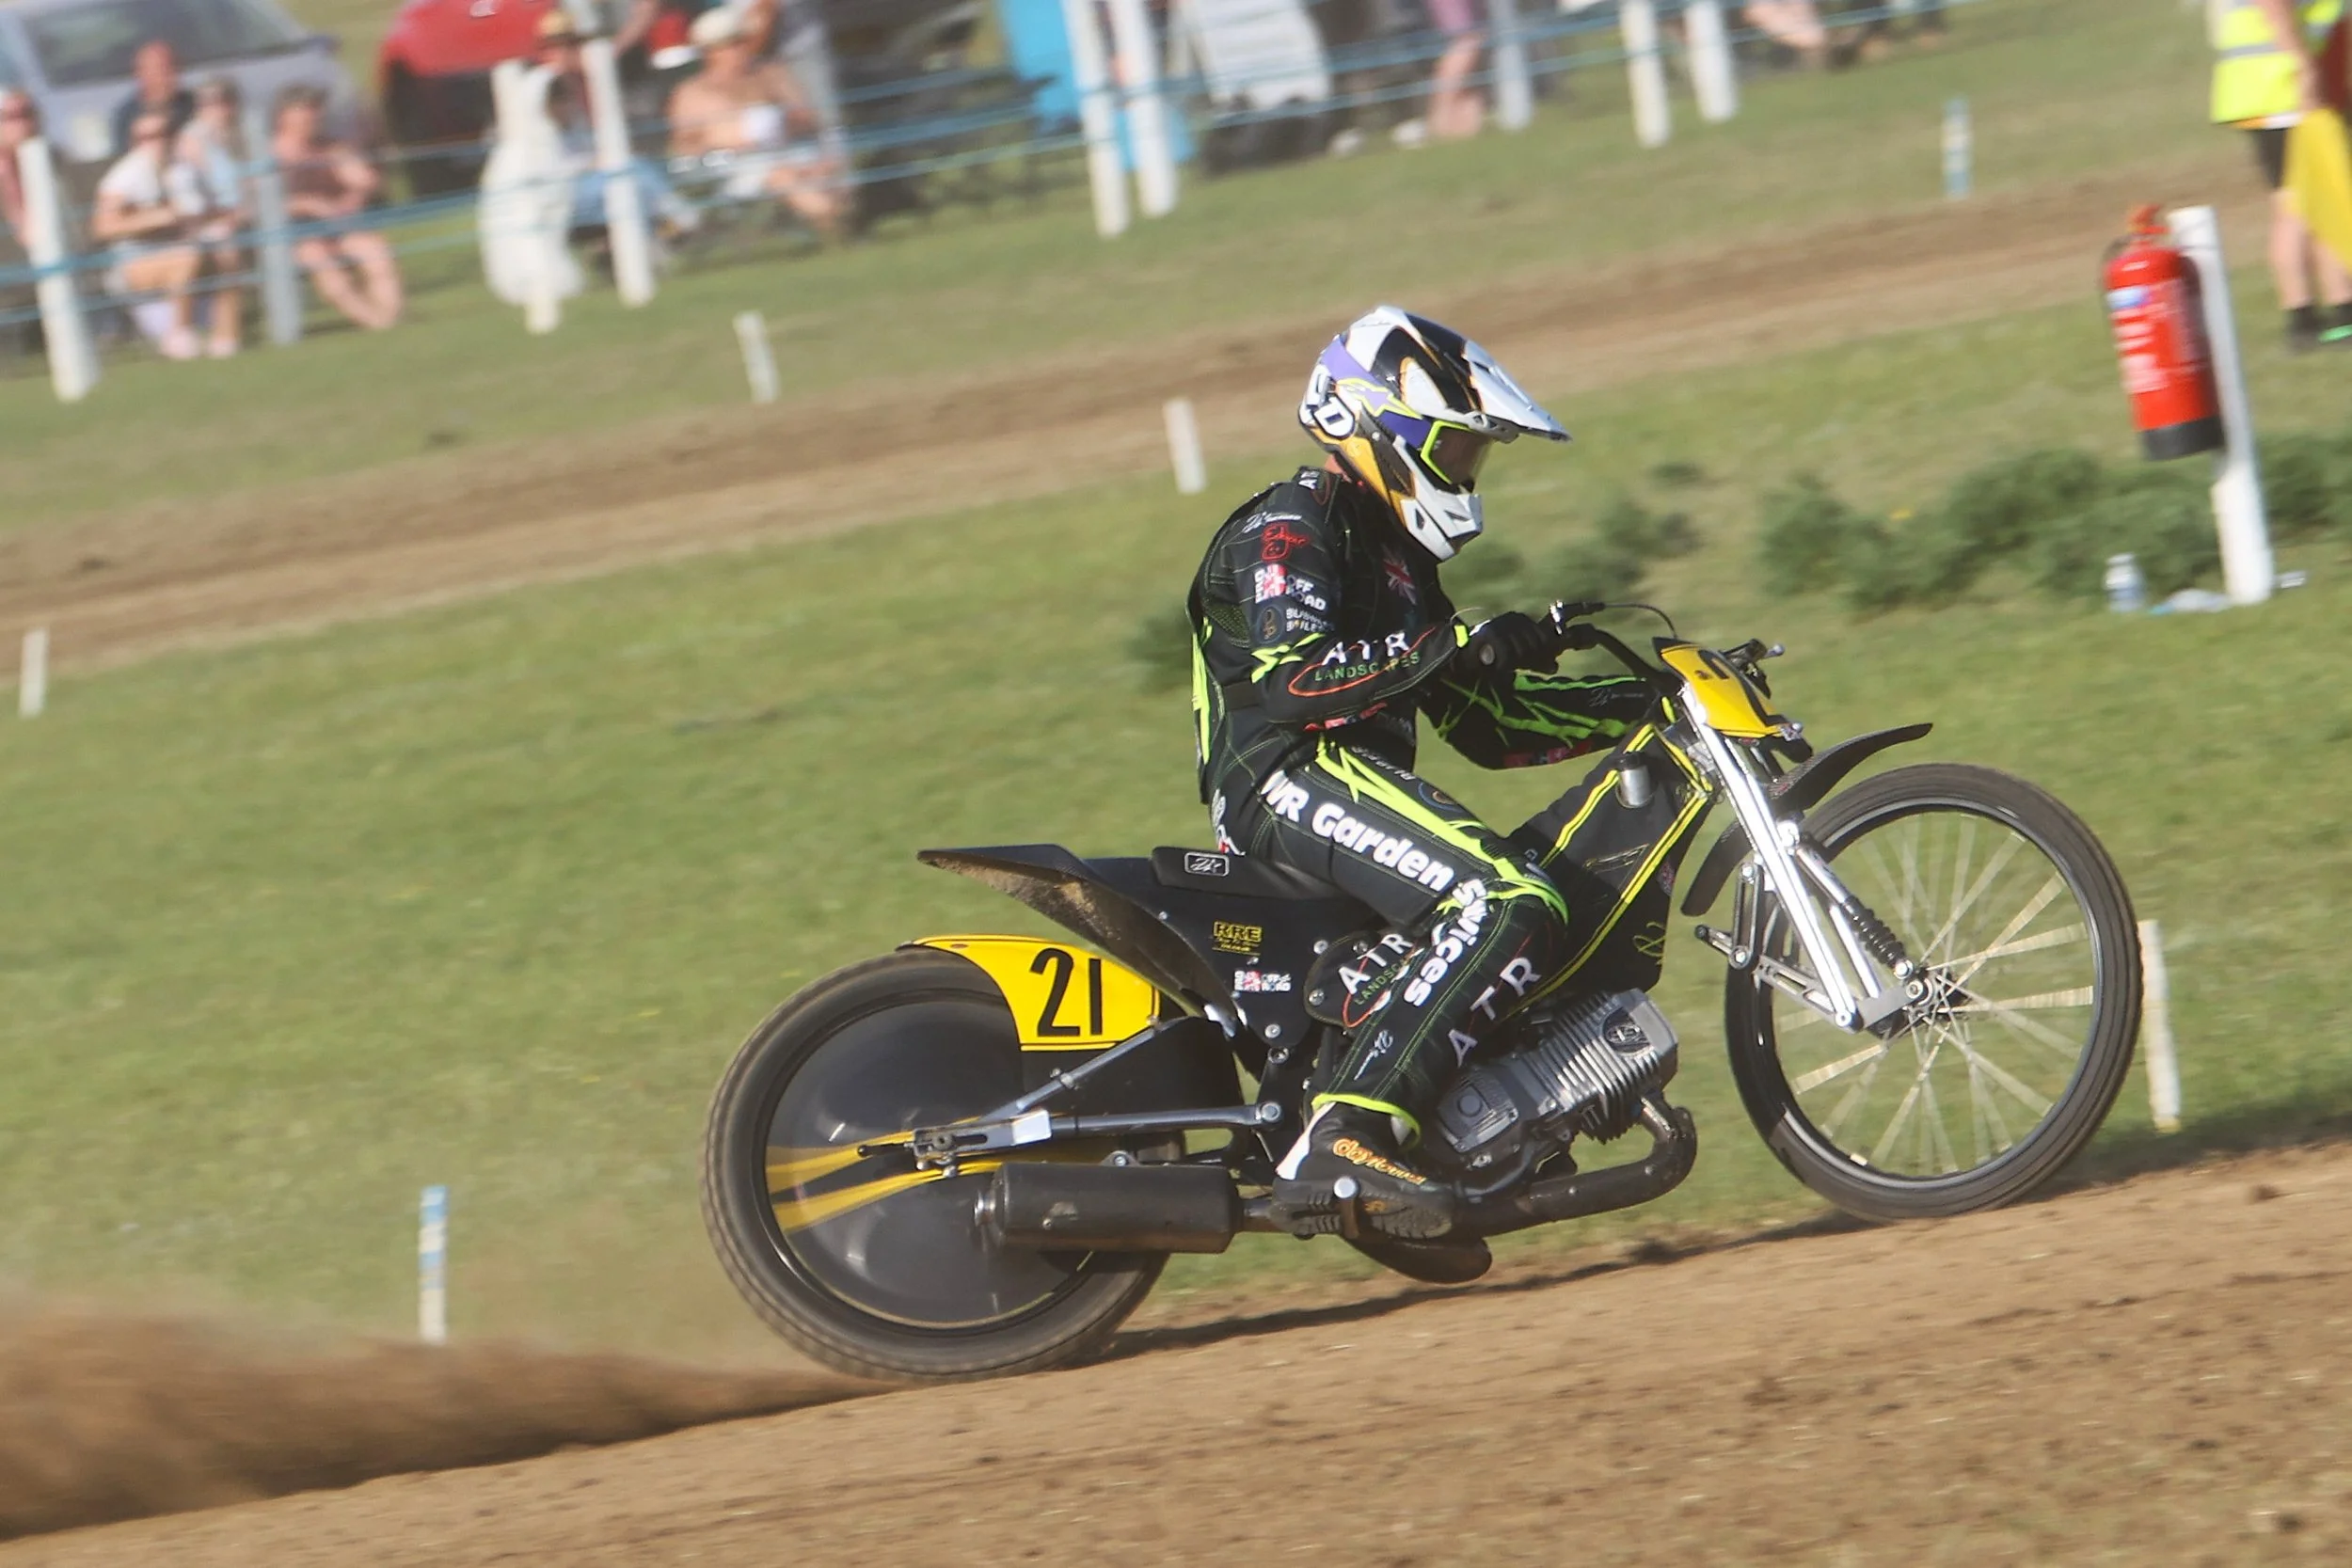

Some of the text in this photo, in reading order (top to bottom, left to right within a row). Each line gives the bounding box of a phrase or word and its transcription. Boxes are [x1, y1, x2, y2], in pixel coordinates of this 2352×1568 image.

[1321, 632, 1410, 666] ATR
[1312, 802, 1454, 892] Garden
[1404, 879, 1486, 1007] Svices
[1030, 947, 1103, 1037] 21
[1338, 933, 1414, 994] ATR
[1448, 958, 1542, 1068] ATR
